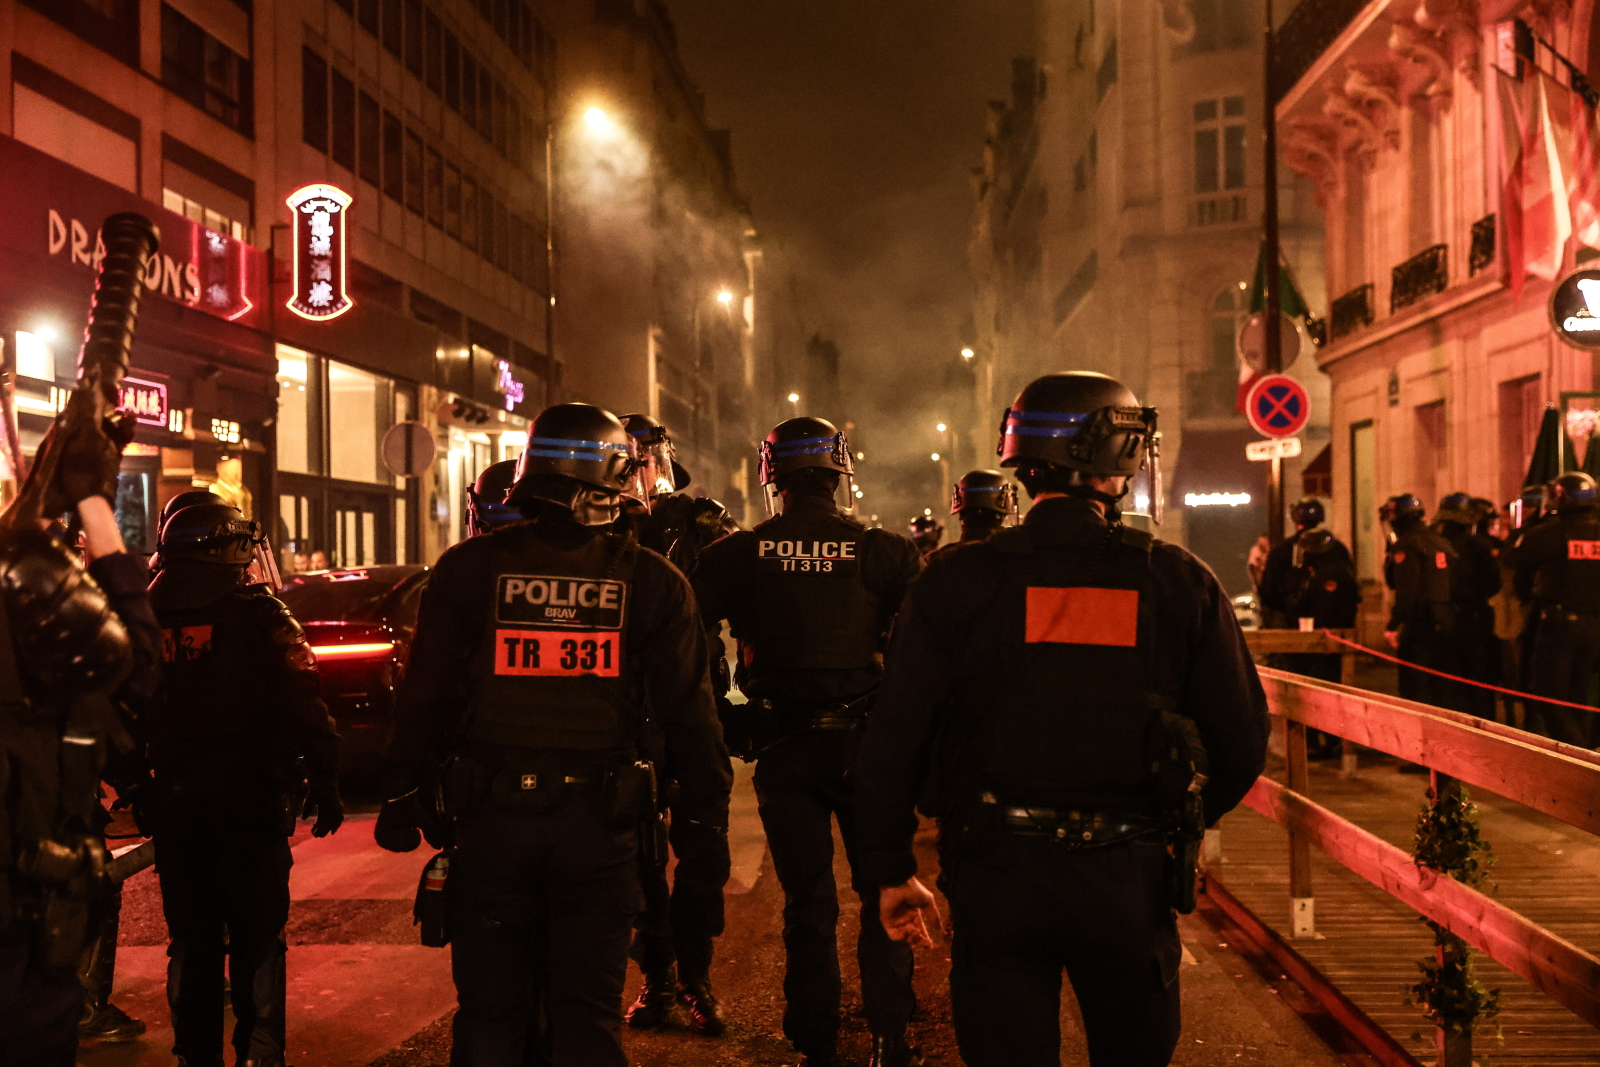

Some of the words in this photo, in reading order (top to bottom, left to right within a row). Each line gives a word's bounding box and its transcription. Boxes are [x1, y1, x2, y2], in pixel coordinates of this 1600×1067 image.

[49, 209, 202, 304] DRAONS
[758, 540, 856, 559] POLICE
[780, 559, 797, 572] TI
[800, 559, 833, 572] 313
[504, 578, 620, 609] POLICE
[544, 606, 577, 620] BRAV
[504, 638, 541, 669] TR
[560, 638, 613, 670] 331
